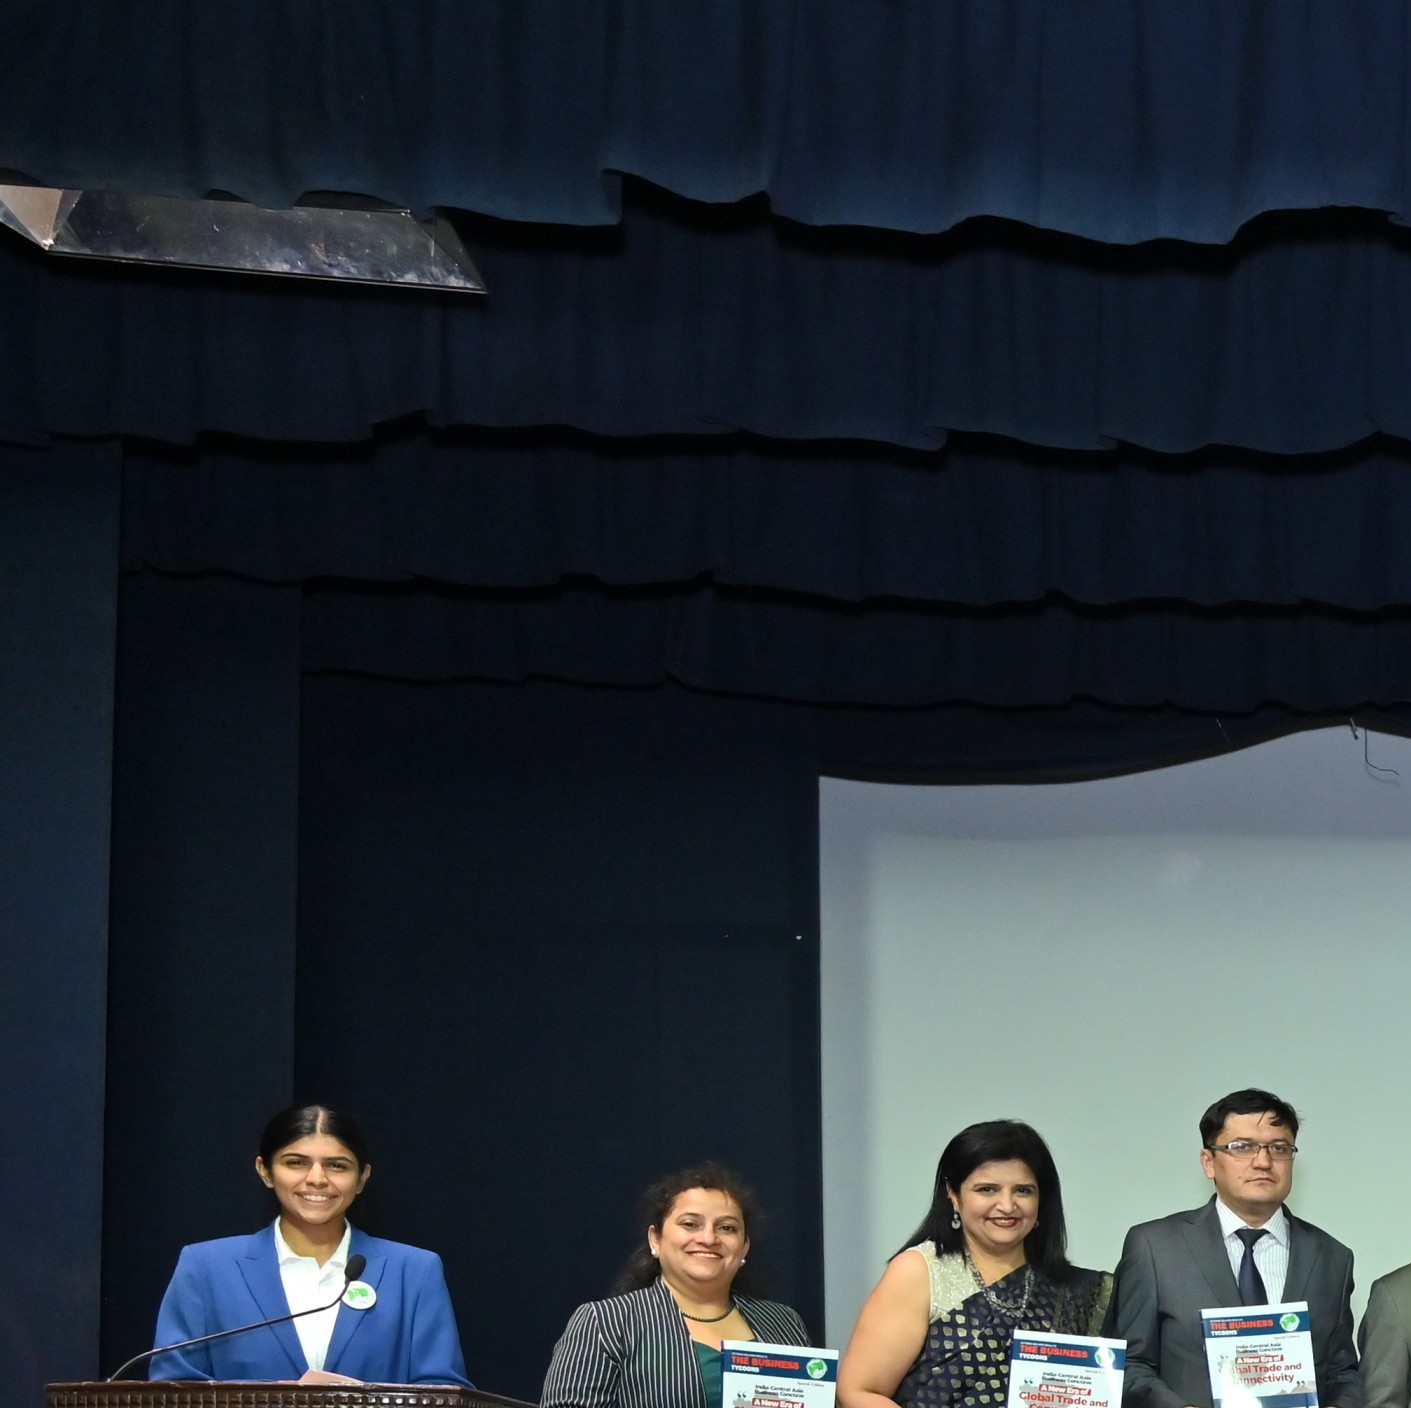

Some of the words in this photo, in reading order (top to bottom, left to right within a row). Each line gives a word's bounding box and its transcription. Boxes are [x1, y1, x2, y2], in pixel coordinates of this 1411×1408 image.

[1210, 1321, 1228, 1330] THE
[1230, 1319, 1274, 1329] BUSINESS
[1020, 1344, 1039, 1353] THE
[1040, 1346, 1088, 1358] BUSINESS
[732, 1356, 749, 1365] THE
[751, 1357, 800, 1370] BUSINESS
[1254, 1365, 1282, 1373] Trade
[1048, 1386, 1065, 1394] New
[762, 1400, 779, 1408] New
[1019, 1392, 1054, 1402] Global
[1056, 1396, 1087, 1406] Trade
[1089, 1399, 1108, 1407] and
